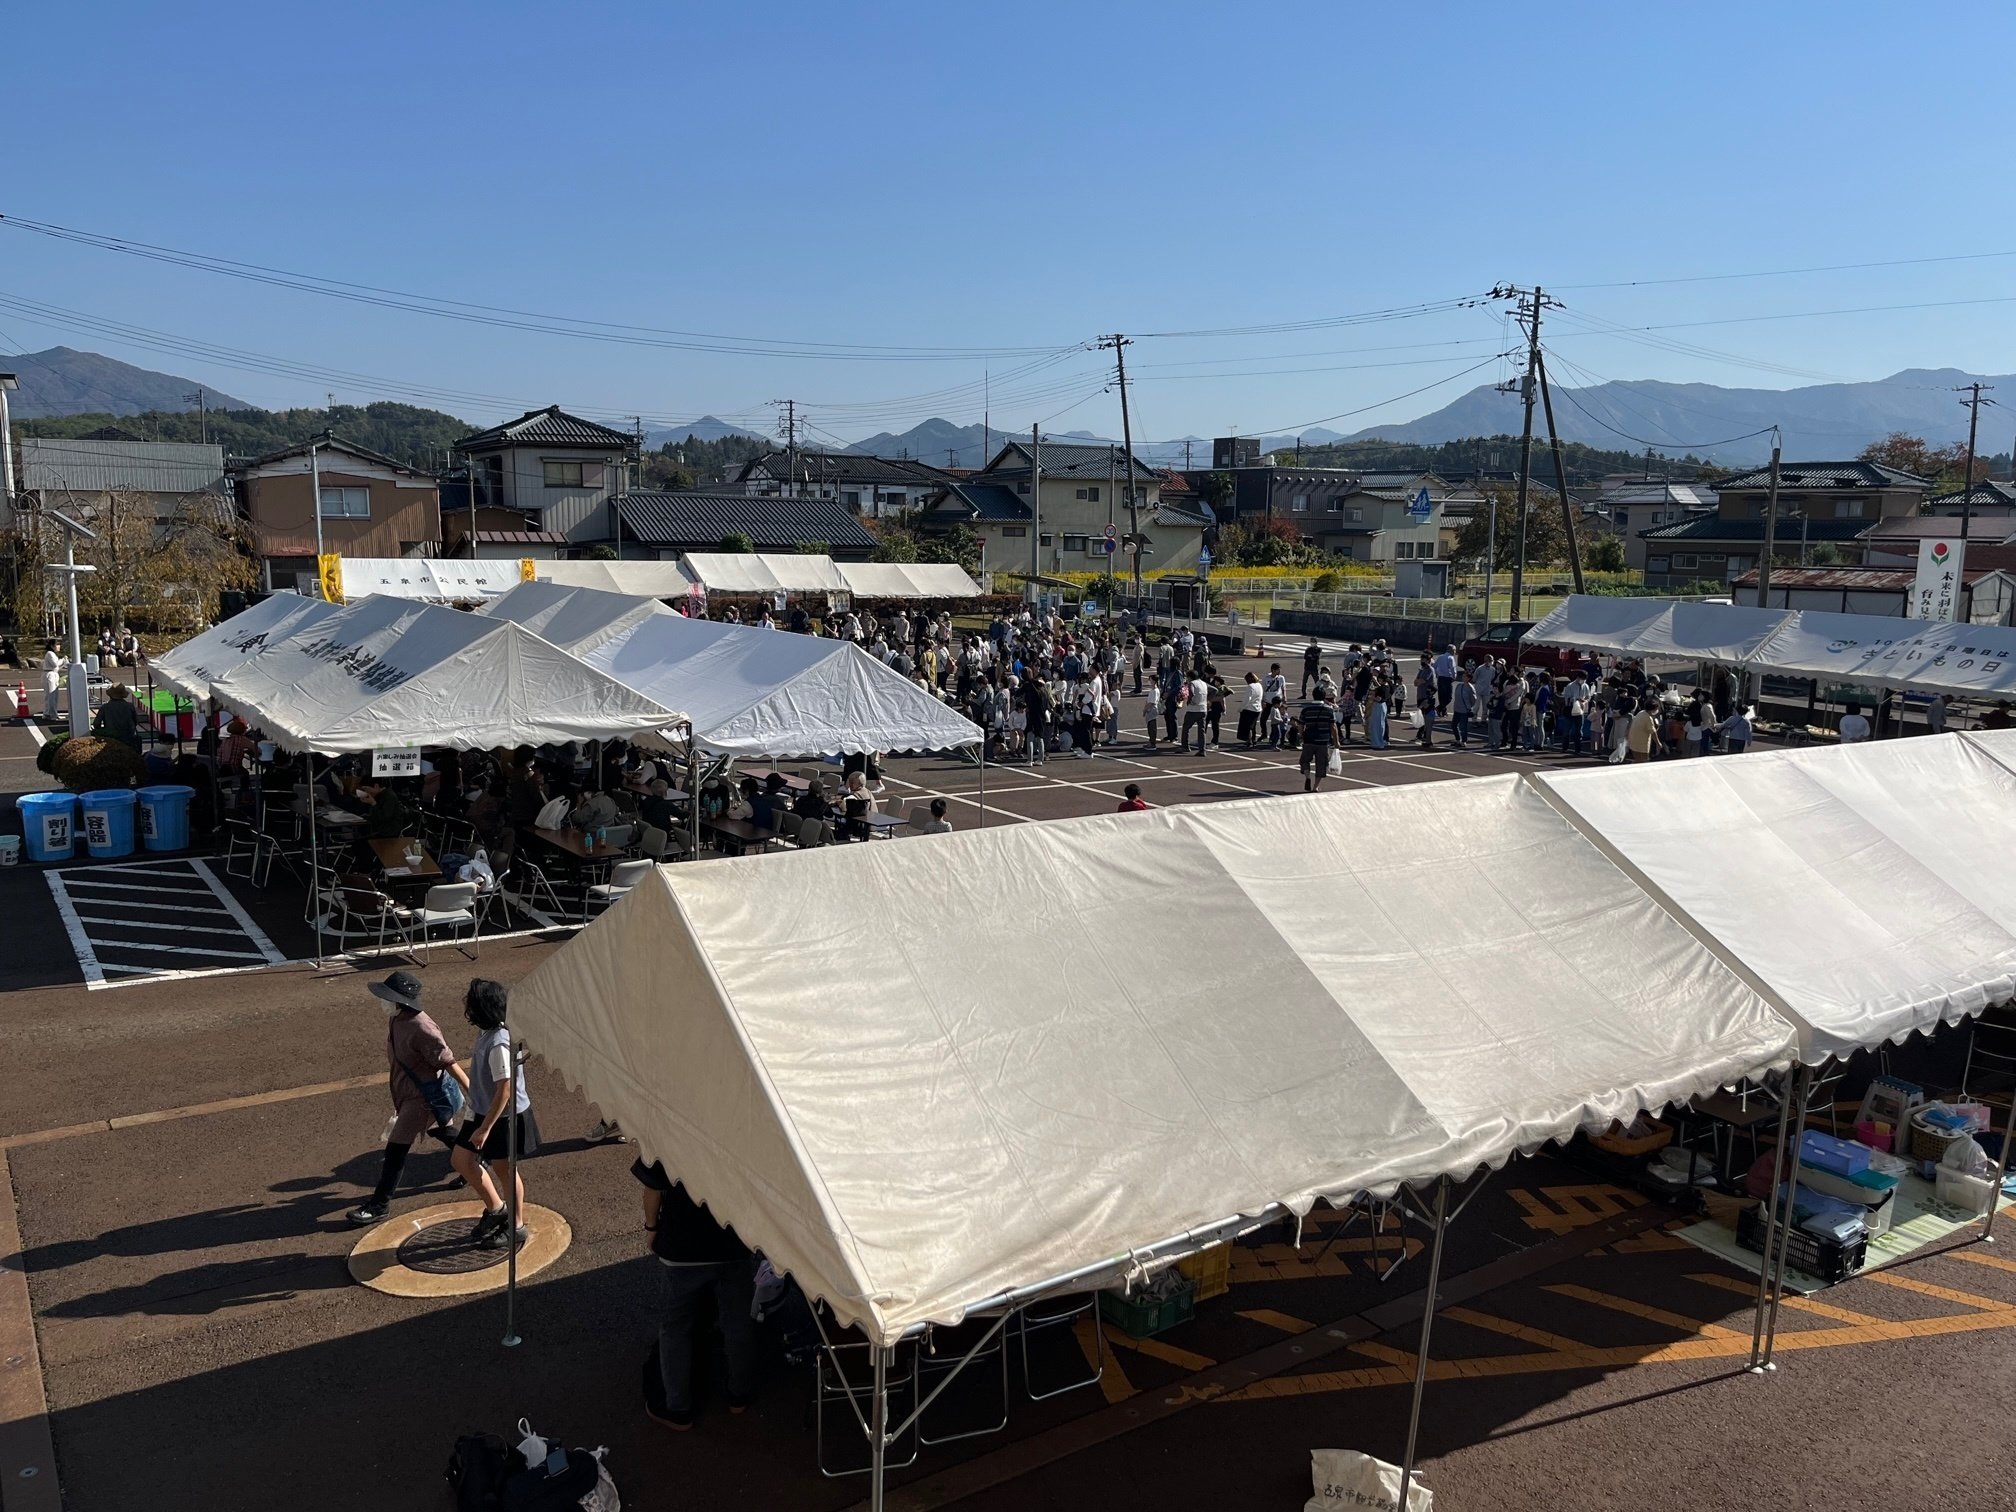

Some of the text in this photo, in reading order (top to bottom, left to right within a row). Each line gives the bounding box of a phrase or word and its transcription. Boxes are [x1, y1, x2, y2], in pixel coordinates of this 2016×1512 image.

[379, 576, 488, 586] 五泉市公民館
[1861, 649, 2002, 673] さといもの日
[379, 762, 414, 772] 抽選箱
[48, 817, 68, 848] 割り箸
[86, 816, 107, 844] 容器
